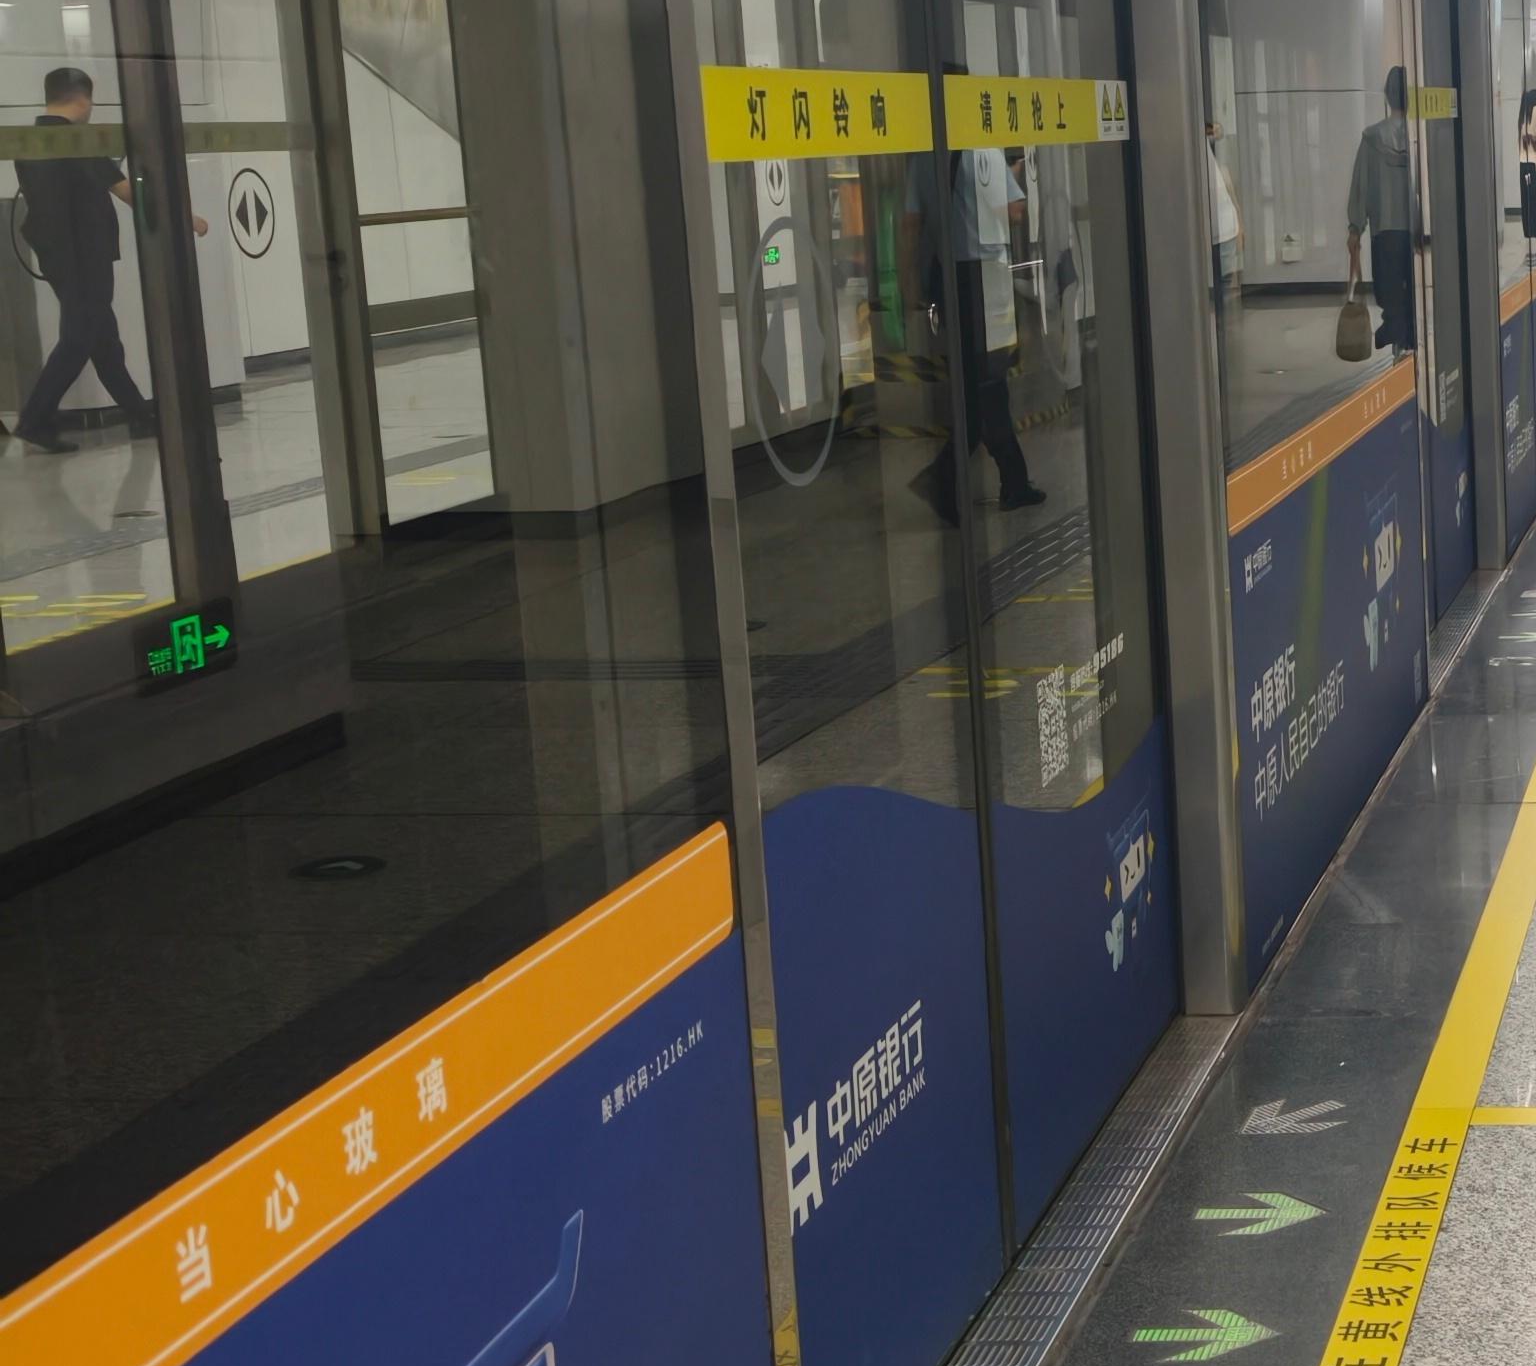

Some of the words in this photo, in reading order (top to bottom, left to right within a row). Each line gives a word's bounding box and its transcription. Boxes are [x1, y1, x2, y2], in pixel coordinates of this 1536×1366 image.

[747, 85, 887, 141] 灯闪铃响
[979, 89, 1067, 134] 请勿抢上
[1251, 643, 1296, 743] 中原银行
[1254, 659, 1345, 822] 中原人民自己的银行
[601, 1019, 704, 1124] 股票代码:1216.HK
[826, 999, 923, 1146] 中原银行
[830, 1098, 897, 1186] ZHONGYUAN
[899, 1066, 926, 1111] BANK
[174, 1056, 450, 1305] 当心玻璃
